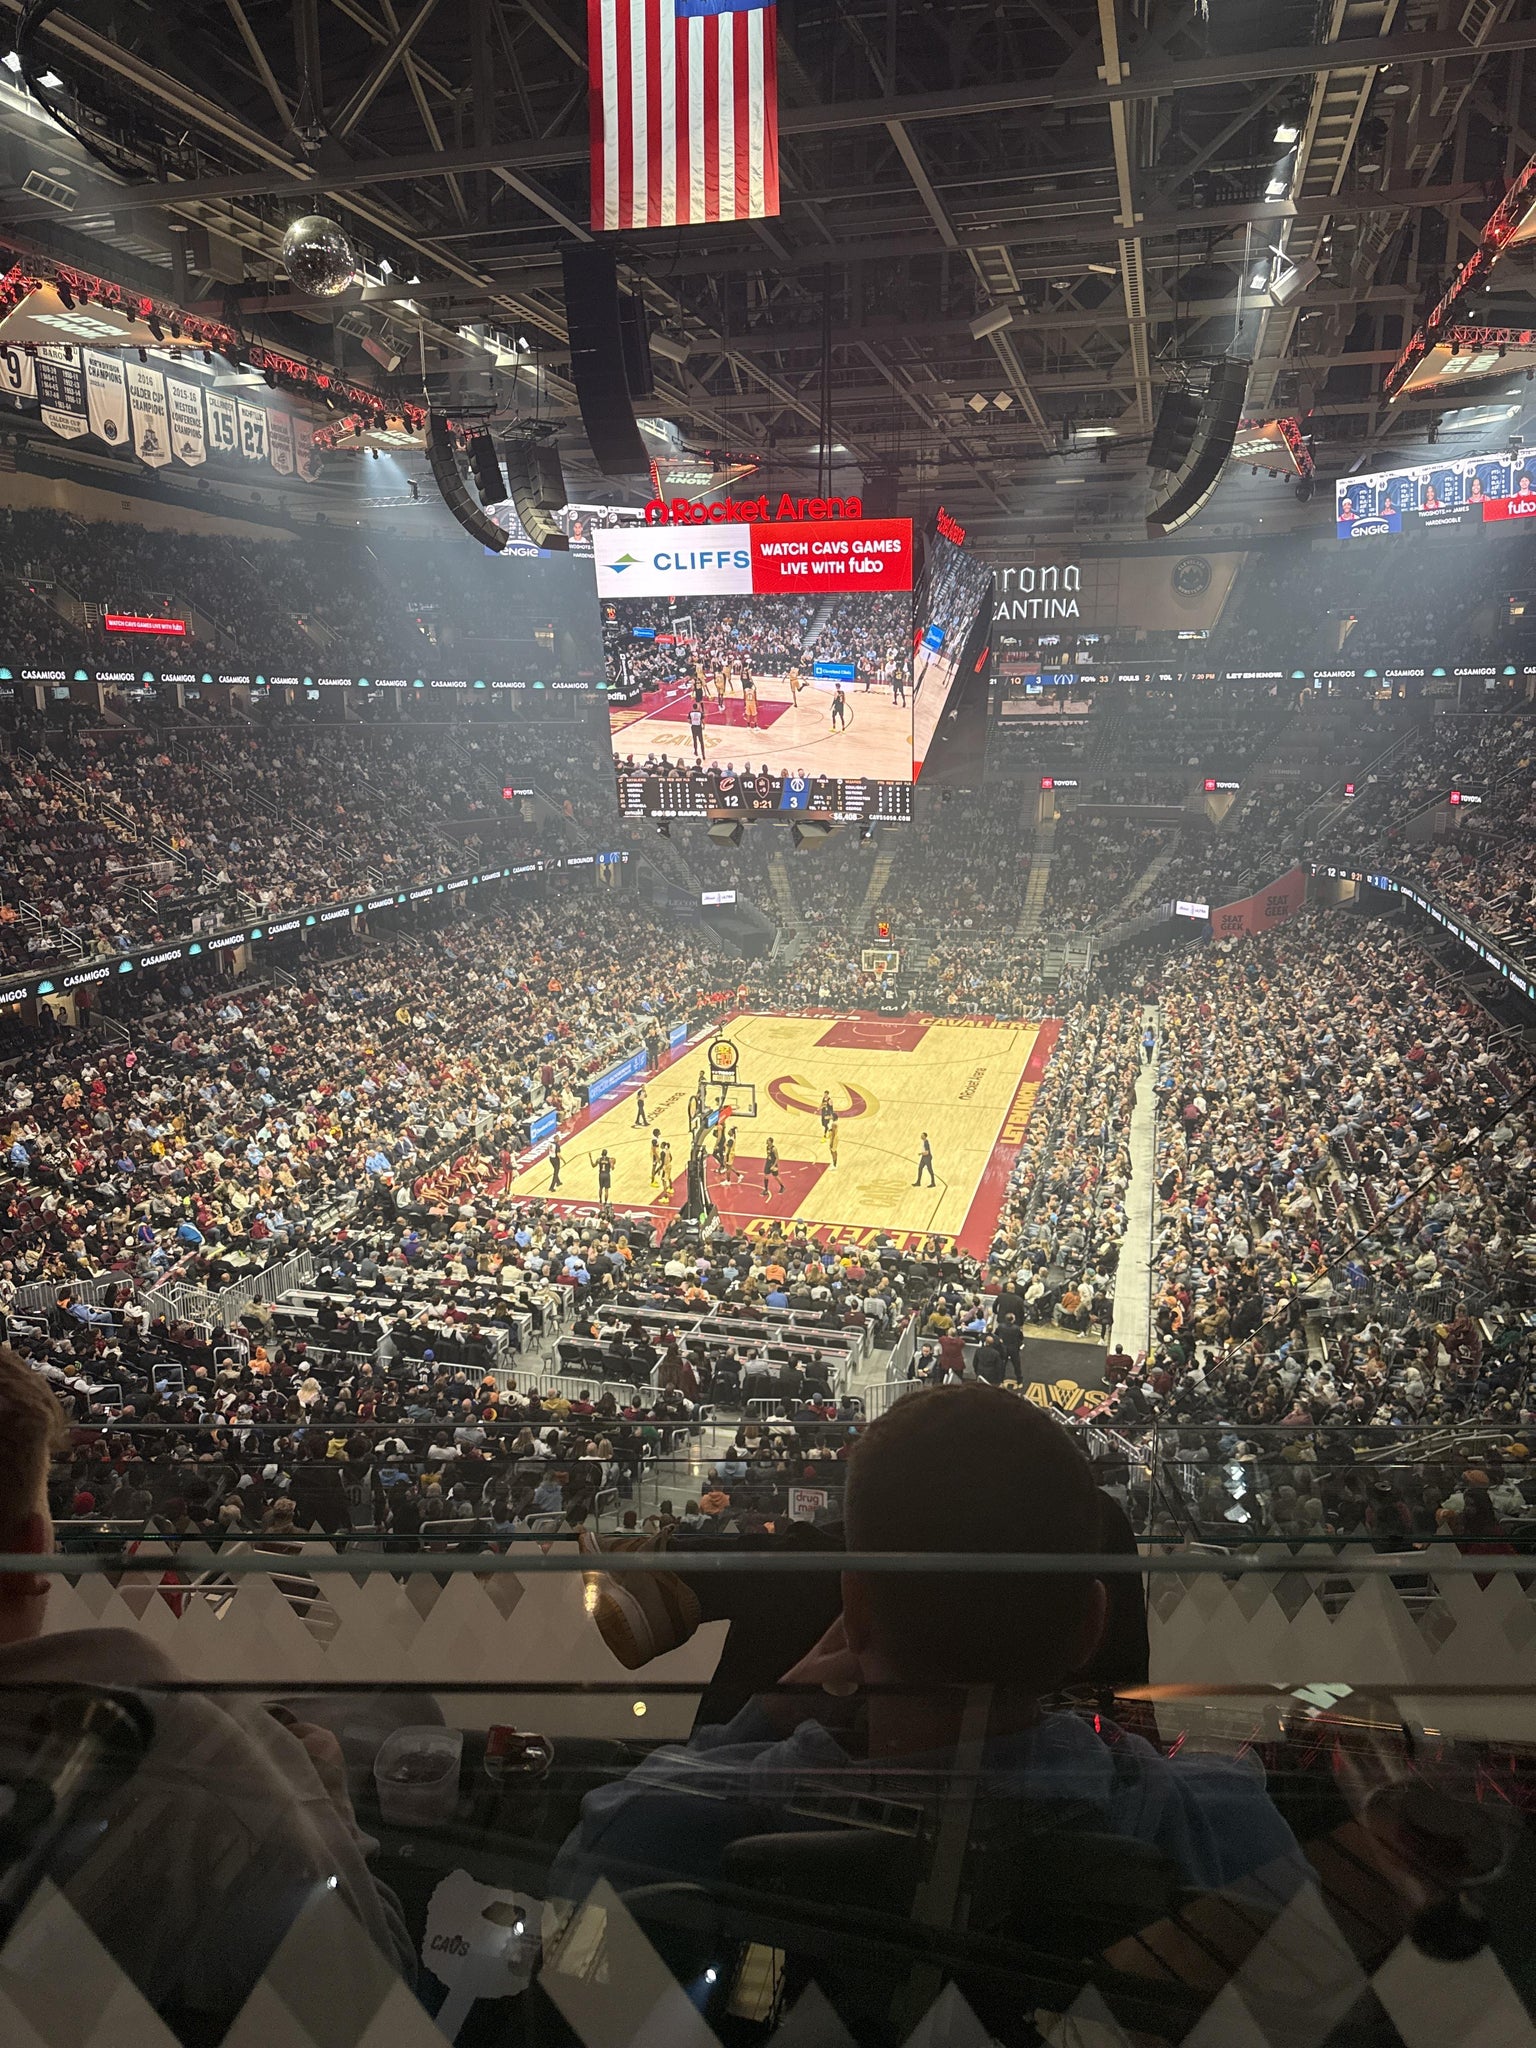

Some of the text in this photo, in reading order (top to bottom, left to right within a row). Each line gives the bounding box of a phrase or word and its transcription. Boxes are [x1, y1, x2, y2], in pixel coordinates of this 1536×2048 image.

[7, 351, 21, 388] 9
[88, 366, 122, 384] CHAMPIONS
[138, 373, 153, 386] 2016
[130, 384, 164, 402] CALDER CUP
[172, 386, 197, 402] 2015-16
[132, 398, 164, 417] CHAMPIONS
[174, 402, 198, 415] WESTERN
[172, 412, 202, 428] CONFERENCE
[174, 424, 202, 440] CHAMPIONS
[213, 411, 233, 445] 15
[244, 421, 264, 456] 27
[672, 493, 863, 525] Rocket Arena
[1508, 500, 1536, 515] fubo
[760, 539, 901, 557] WATCH CAVS GAMES
[653, 550, 750, 571] CLIFFS
[780, 557, 884, 576] LIVE WITH fubo
[172, 623, 183, 631] fubo
[21, 670, 66, 680] CASAMIGOS
[96, 672, 135, 681] CASAMIGOS
[161, 673, 196, 682] CASAMIGOS
[1385, 669, 1425, 677] CASAMIGOS
[1454, 668, 1496, 676] CASAMIGOS
[219, 675, 250, 684] CASAMIGOS
[270, 677, 299, 685] CASAMIGOS
[318, 678, 352, 686] CASAMIGOS
[375, 679, 407, 687] CASAMIGOS
[431, 680, 467, 688] CASAMIGOS
[492, 681, 526, 689] CASAMIGOS
[1036, 676, 1042, 684] 3
[724, 796, 739, 807] 12
[752, 800, 773, 808] 9:21
[790, 797, 798, 808] 3
[1460, 794, 1482, 803] TOYOTA
[557, 860, 562, 868] 4
[567, 856, 594, 865] REBOUNDS
[1327, 868, 1336, 877] 12
[1351, 872, 1363, 881] 9:21
[1374, 877, 1379, 886] 3
[409, 888, 433, 900] CASAMIGOS
[1266, 895, 1289, 905] SEAT
[368, 897, 394, 910] CASAMIGOS
[321, 908, 350, 922] CASAMIGOS
[1265, 906, 1288, 917] GEEK
[1222, 914, 1244, 923] SEAT
[268, 920, 300, 935] CASAMIGOS
[1221, 922, 1244, 931] GEEK
[208, 933, 244, 950] CASAMIGOS
[140, 949, 182, 967] CASAMIGOS
[64, 967, 110, 987] CASAMIGOS
[785, 1012, 861, 1020] CLIFFS
[918, 1018, 1041, 1031] CAVALIERS
[1000, 1123, 1025, 1145] LET
[796, 1490, 819, 1506] drug
[798, 1504, 817, 1512] mar
